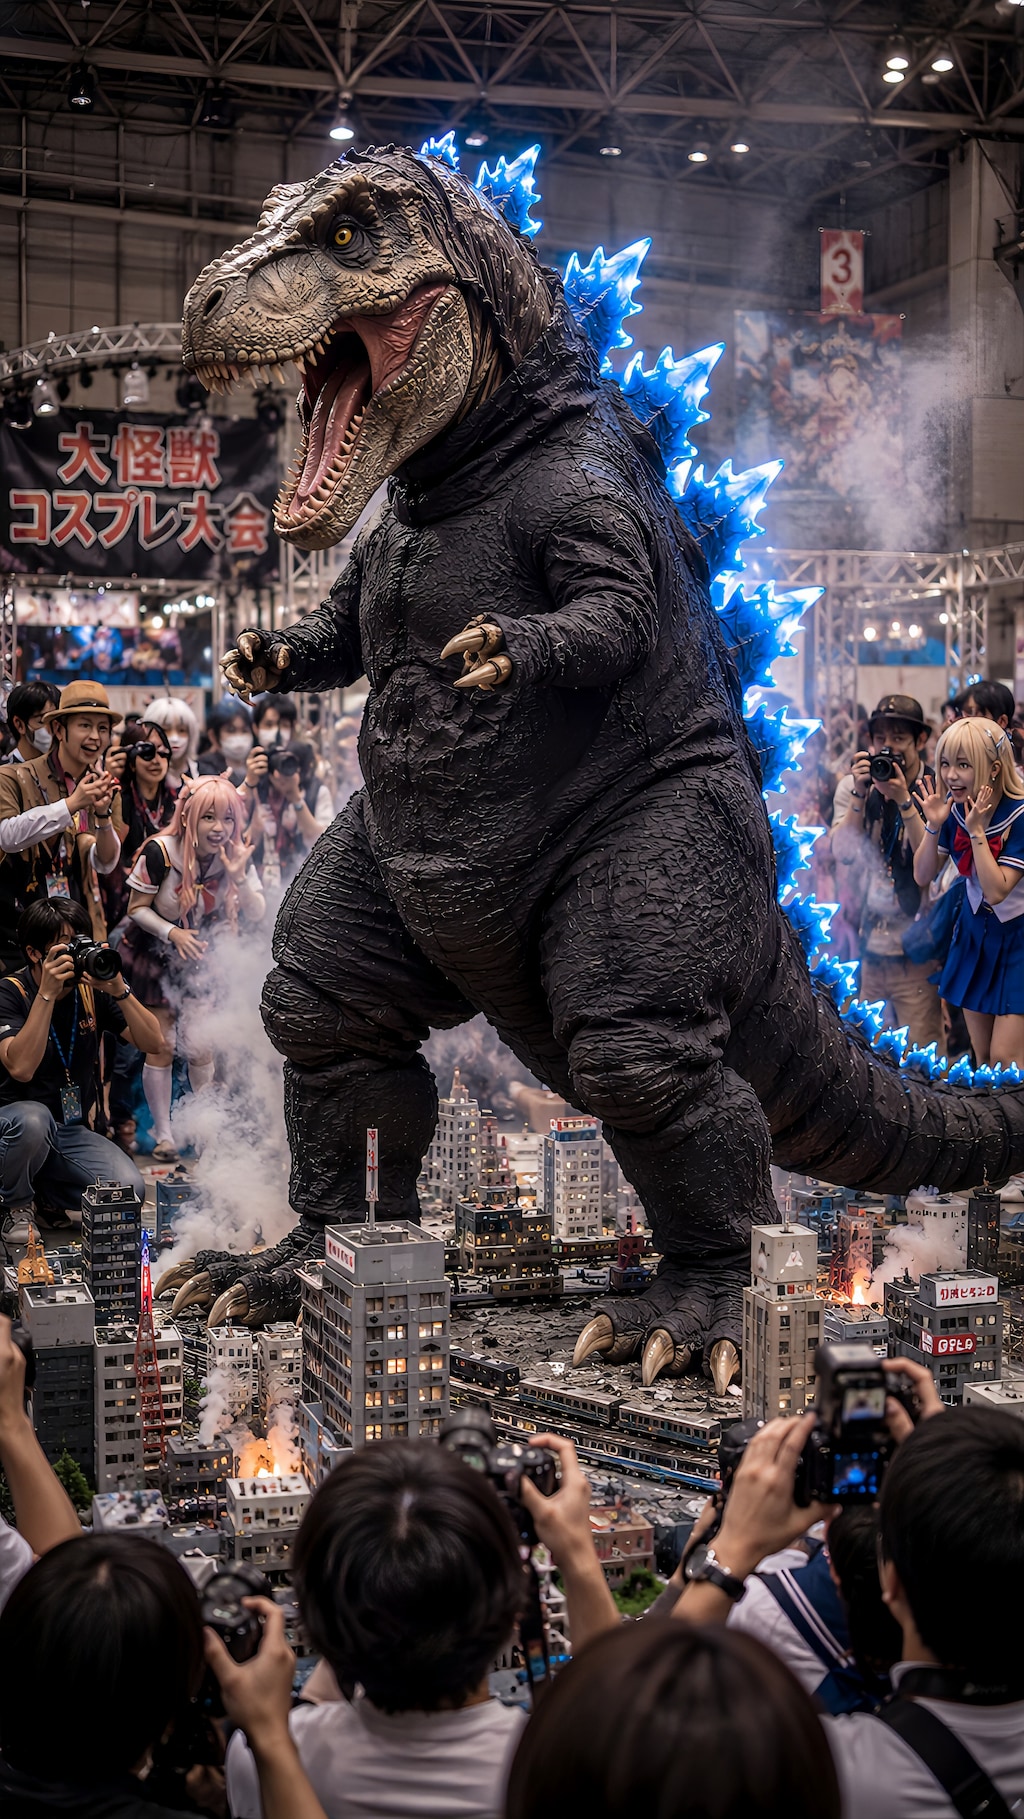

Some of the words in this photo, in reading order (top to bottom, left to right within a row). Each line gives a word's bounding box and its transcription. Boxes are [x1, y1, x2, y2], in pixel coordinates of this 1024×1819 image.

[831, 247, 852, 284] 3
[57, 421, 222, 489] 大怪獣
[9, 486, 269, 553] コスプレ大会
